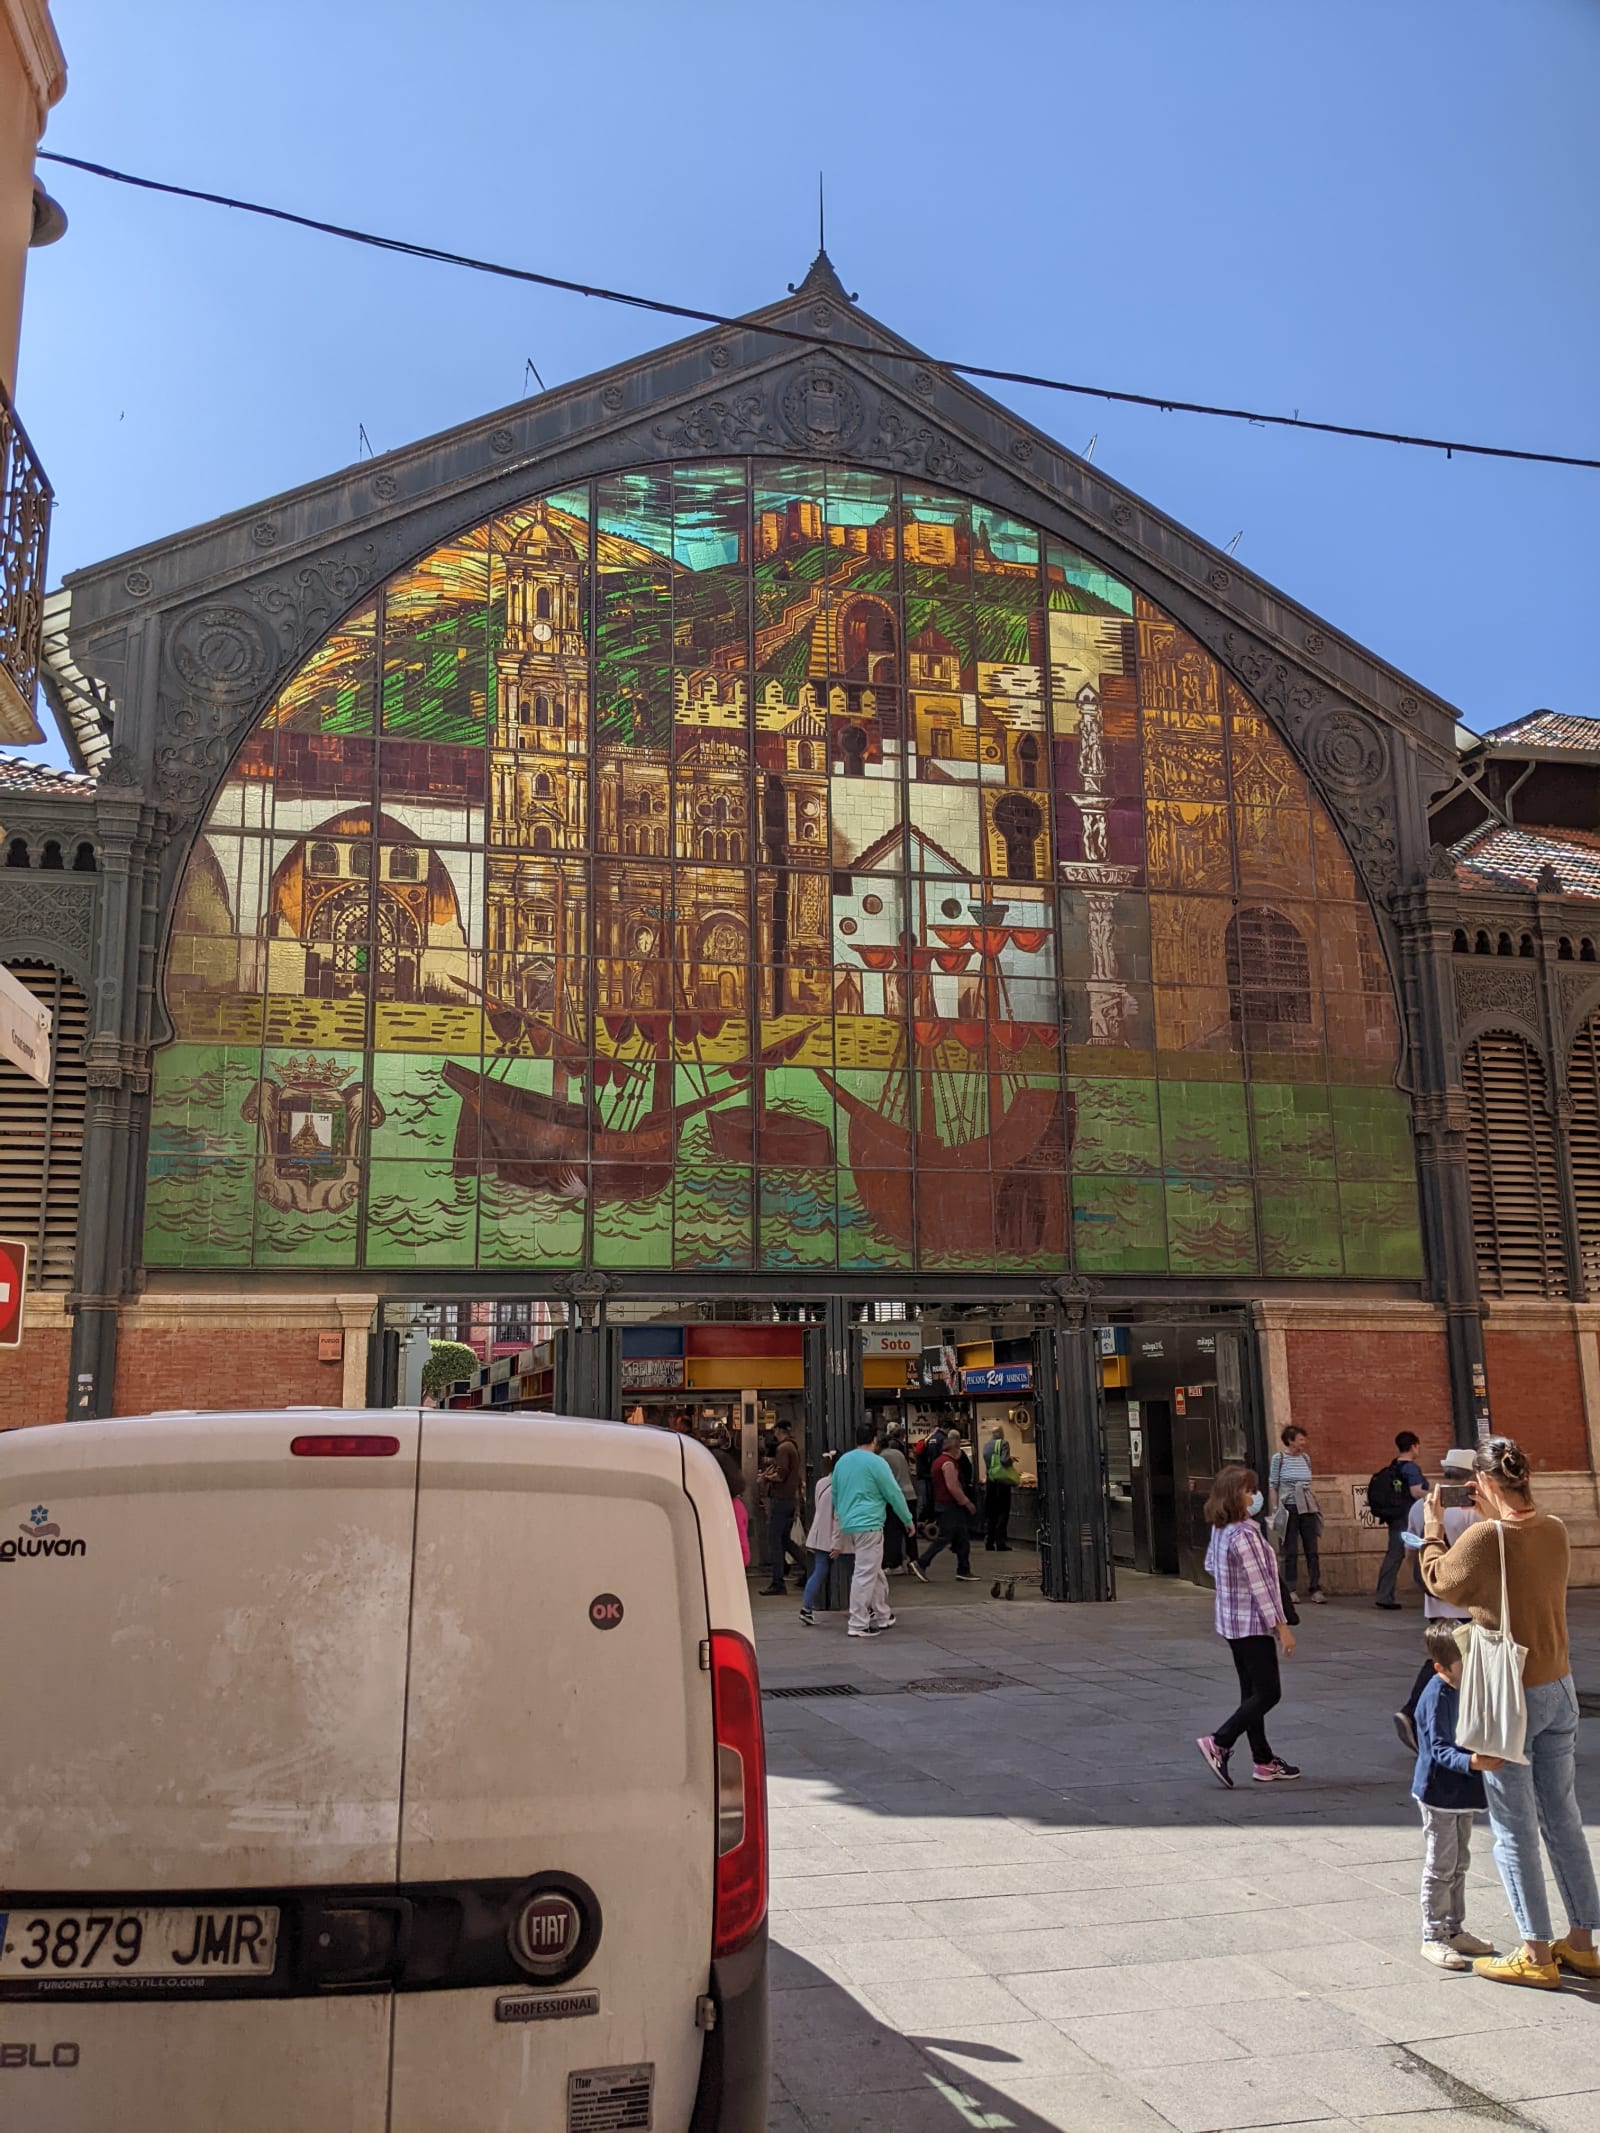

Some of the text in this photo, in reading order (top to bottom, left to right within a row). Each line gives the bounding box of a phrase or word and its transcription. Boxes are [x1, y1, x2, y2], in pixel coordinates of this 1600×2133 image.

[881, 1338, 911, 1350] Soto
[967, 1370, 1027, 1388] PESCADOS Rey MARISCOS
[592, 1603, 620, 1620] OK
[532, 1914, 568, 1944] FIAT
[20, 1914, 263, 1969] 3879 JMR
[37, 1980, 104, 1990] FURGONETAS
[505, 1998, 592, 2015] PROFESSIONAL
[0, 2042, 80, 2068] BLO
